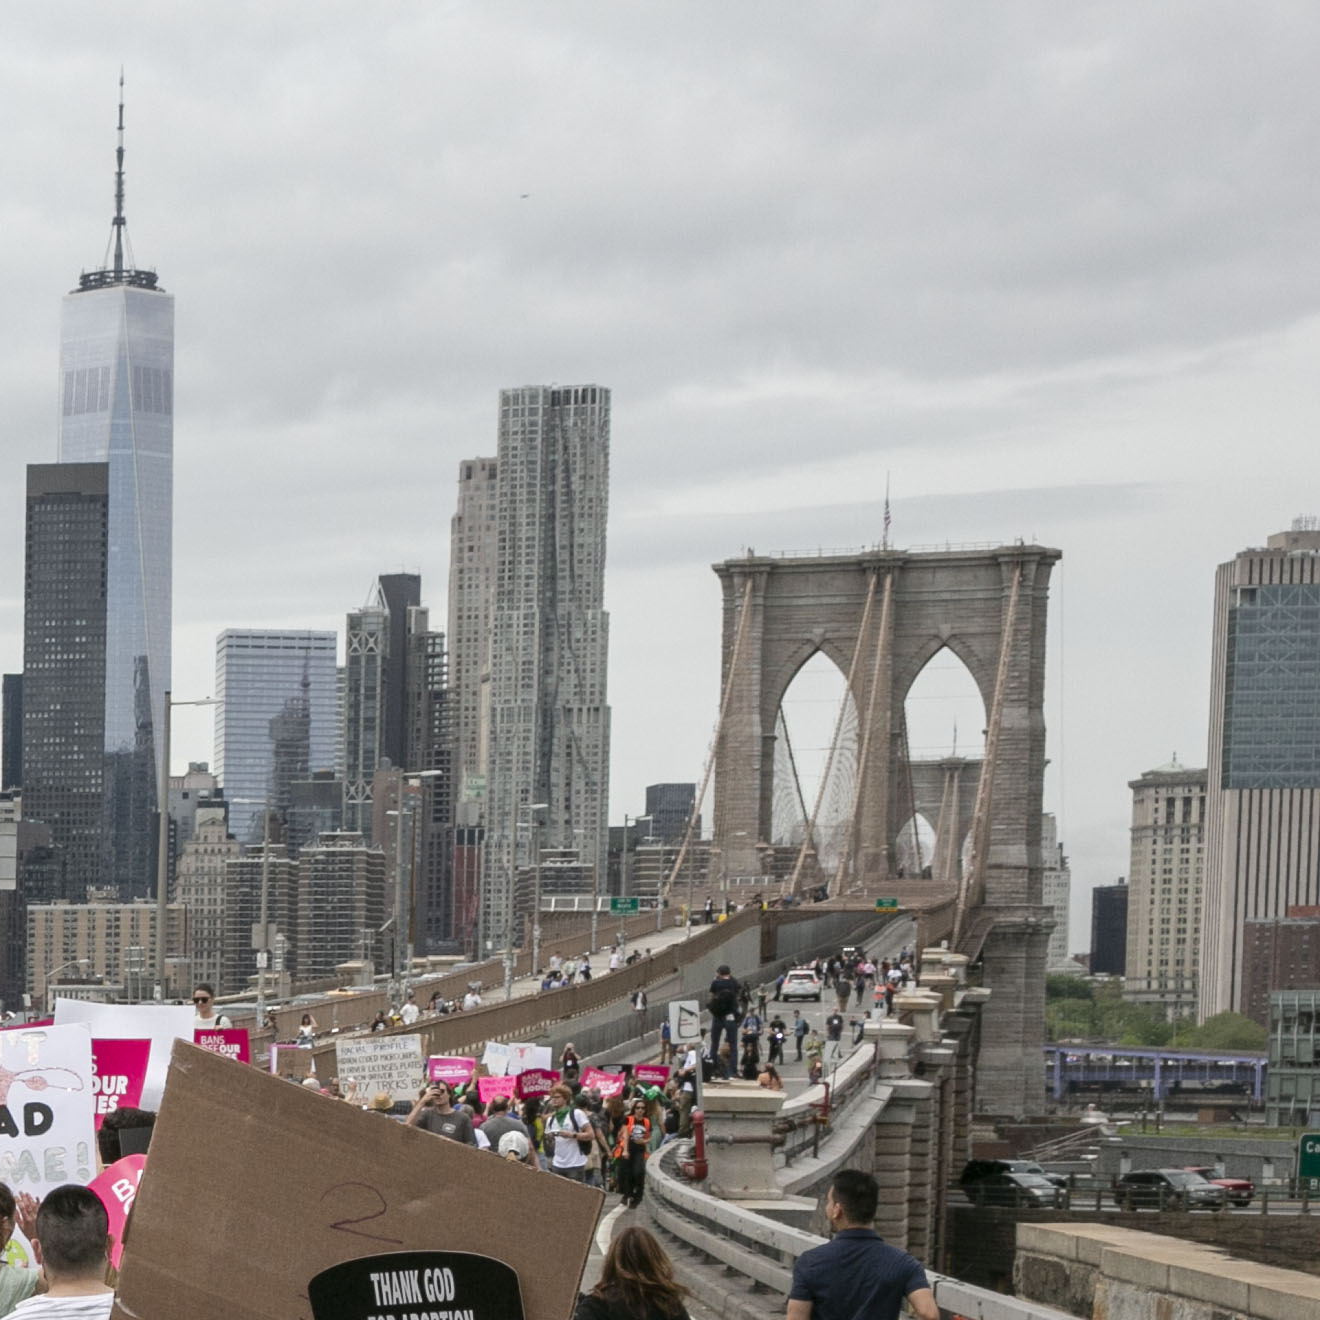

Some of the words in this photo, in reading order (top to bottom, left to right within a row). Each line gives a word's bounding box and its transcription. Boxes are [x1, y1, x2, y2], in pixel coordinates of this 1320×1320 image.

[200, 1035, 225, 1045] BANS
[219, 1044, 241, 1053] OUR
[370, 1269, 423, 1306] THANK
[423, 1267, 456, 1303] GOD
